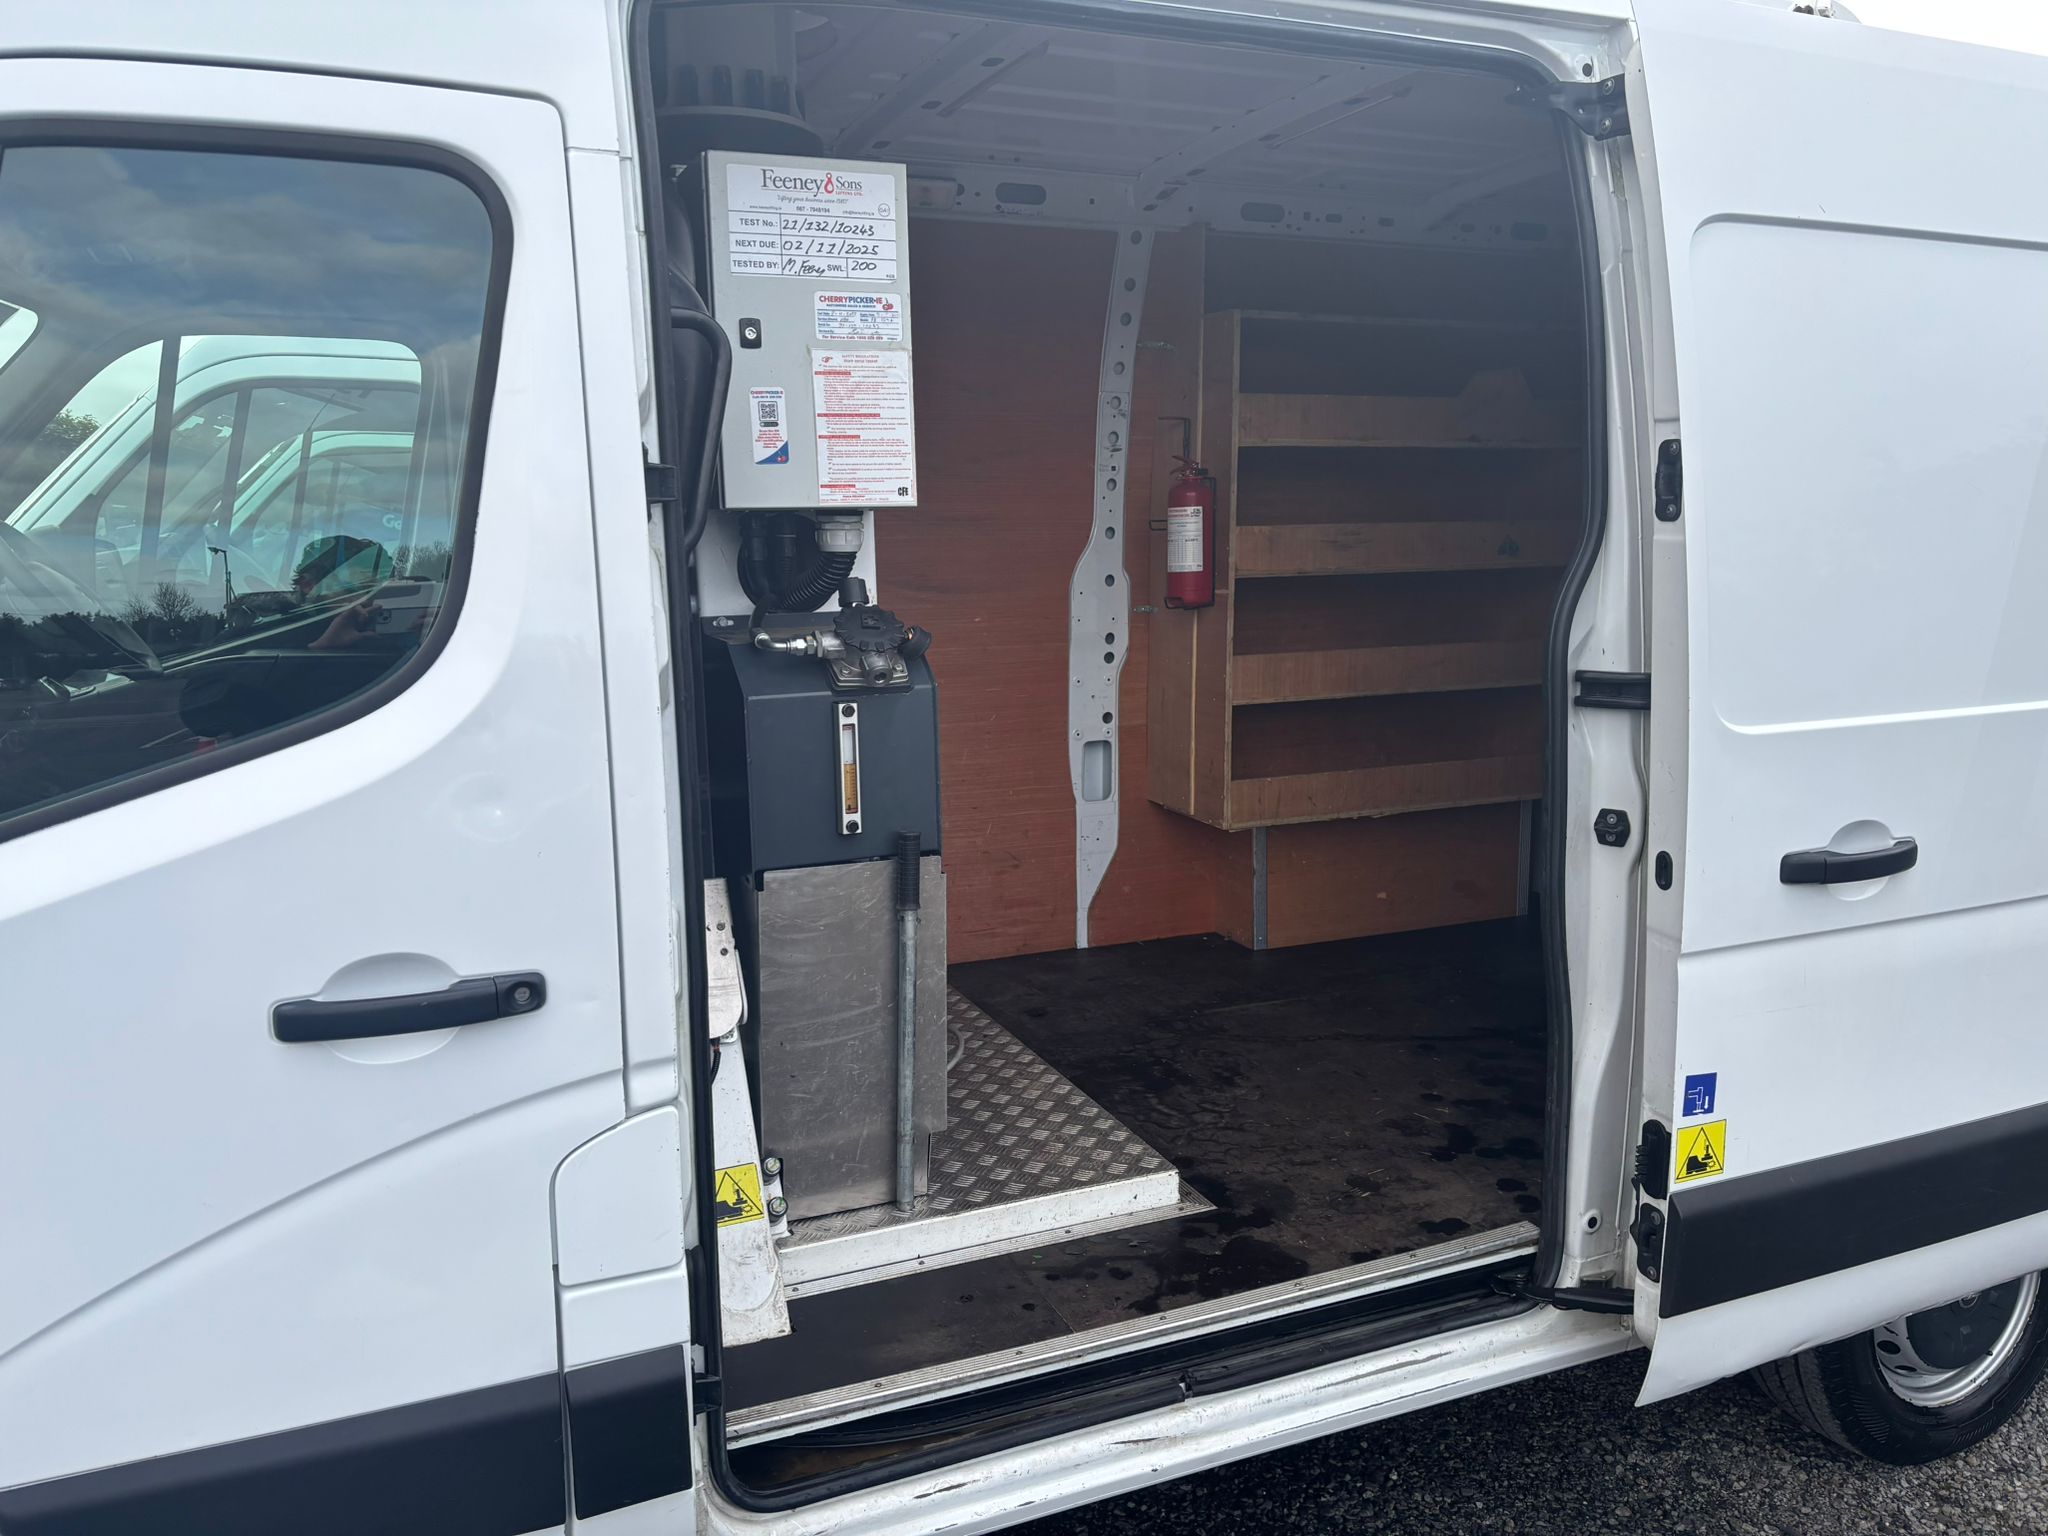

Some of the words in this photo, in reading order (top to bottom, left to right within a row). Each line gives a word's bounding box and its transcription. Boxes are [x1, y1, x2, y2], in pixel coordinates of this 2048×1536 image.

[761, 168, 824, 197] Feeney
[836, 176, 862, 190] Sons
[740, 217, 760, 226] TEST
[735, 239, 757, 248] NEXT
[759, 240, 779, 249] DUE:
[732, 259, 764, 269] TESTED
[766, 261, 780, 269] BY:
[851, 260, 877, 271] 200
